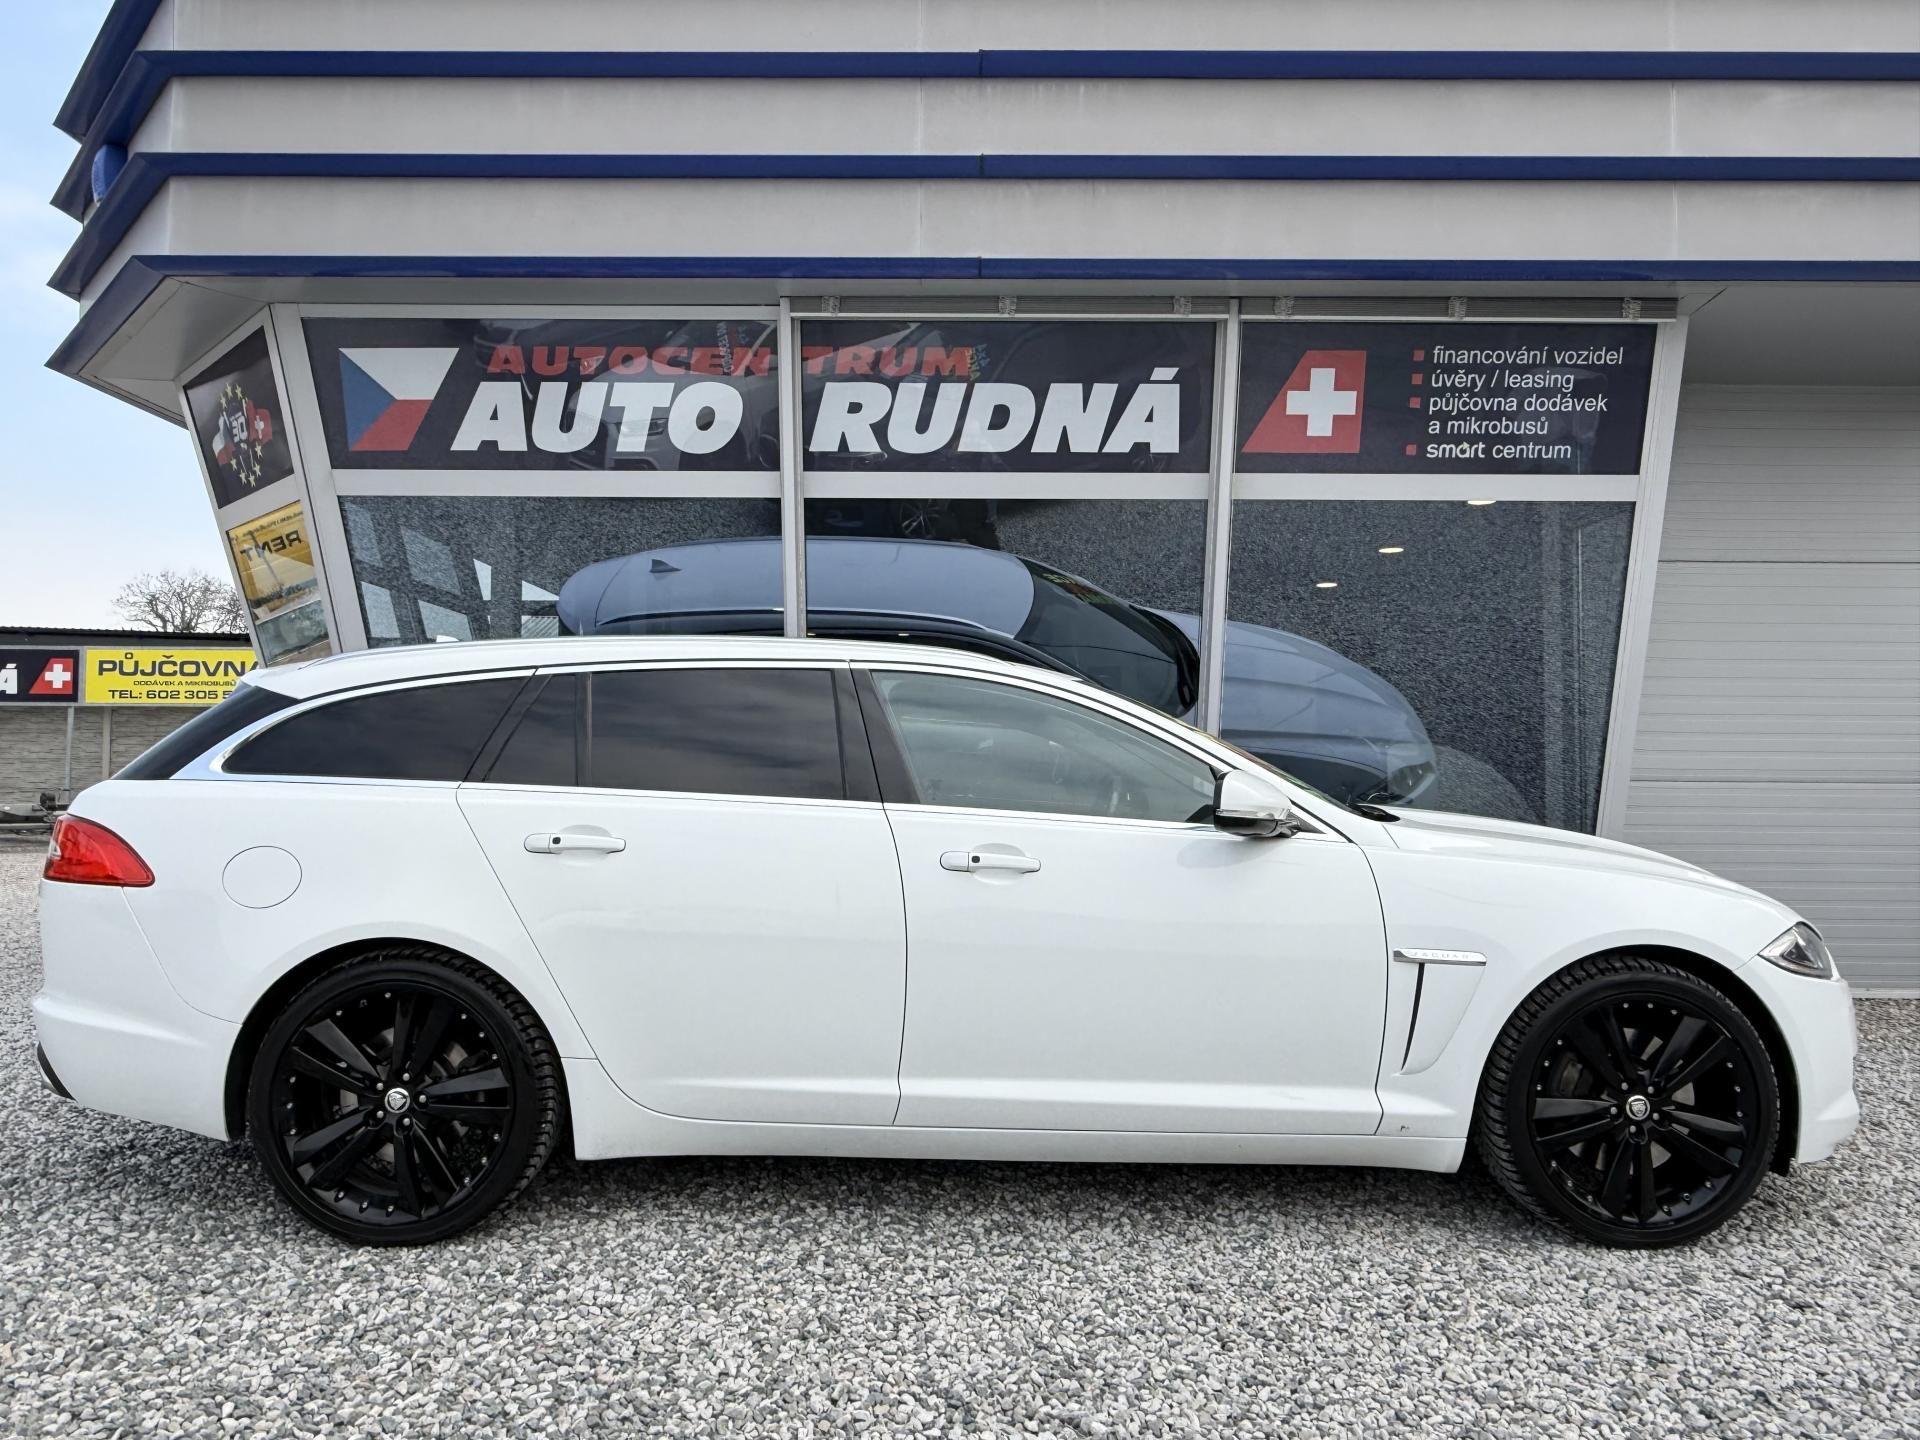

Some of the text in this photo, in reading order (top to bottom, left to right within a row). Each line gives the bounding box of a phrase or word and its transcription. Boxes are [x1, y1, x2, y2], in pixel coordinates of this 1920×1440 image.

[1432, 345, 1624, 365] financování vozidel
[1431, 369, 1486, 392] úvěry
[1504, 370, 1575, 393] leasing
[450, 367, 1180, 455] AUTO RUDNÁ
[1428, 393, 1608, 415] půjčovna dodávek
[1428, 417, 1549, 435] a mikrobusů
[1426, 441, 1572, 459] smart centrum
[97, 652, 258, 677] PŮJČOVN
[108, 689, 142, 699] TEL:
[146, 690, 180, 700] 602
[184, 690, 218, 700] 305
